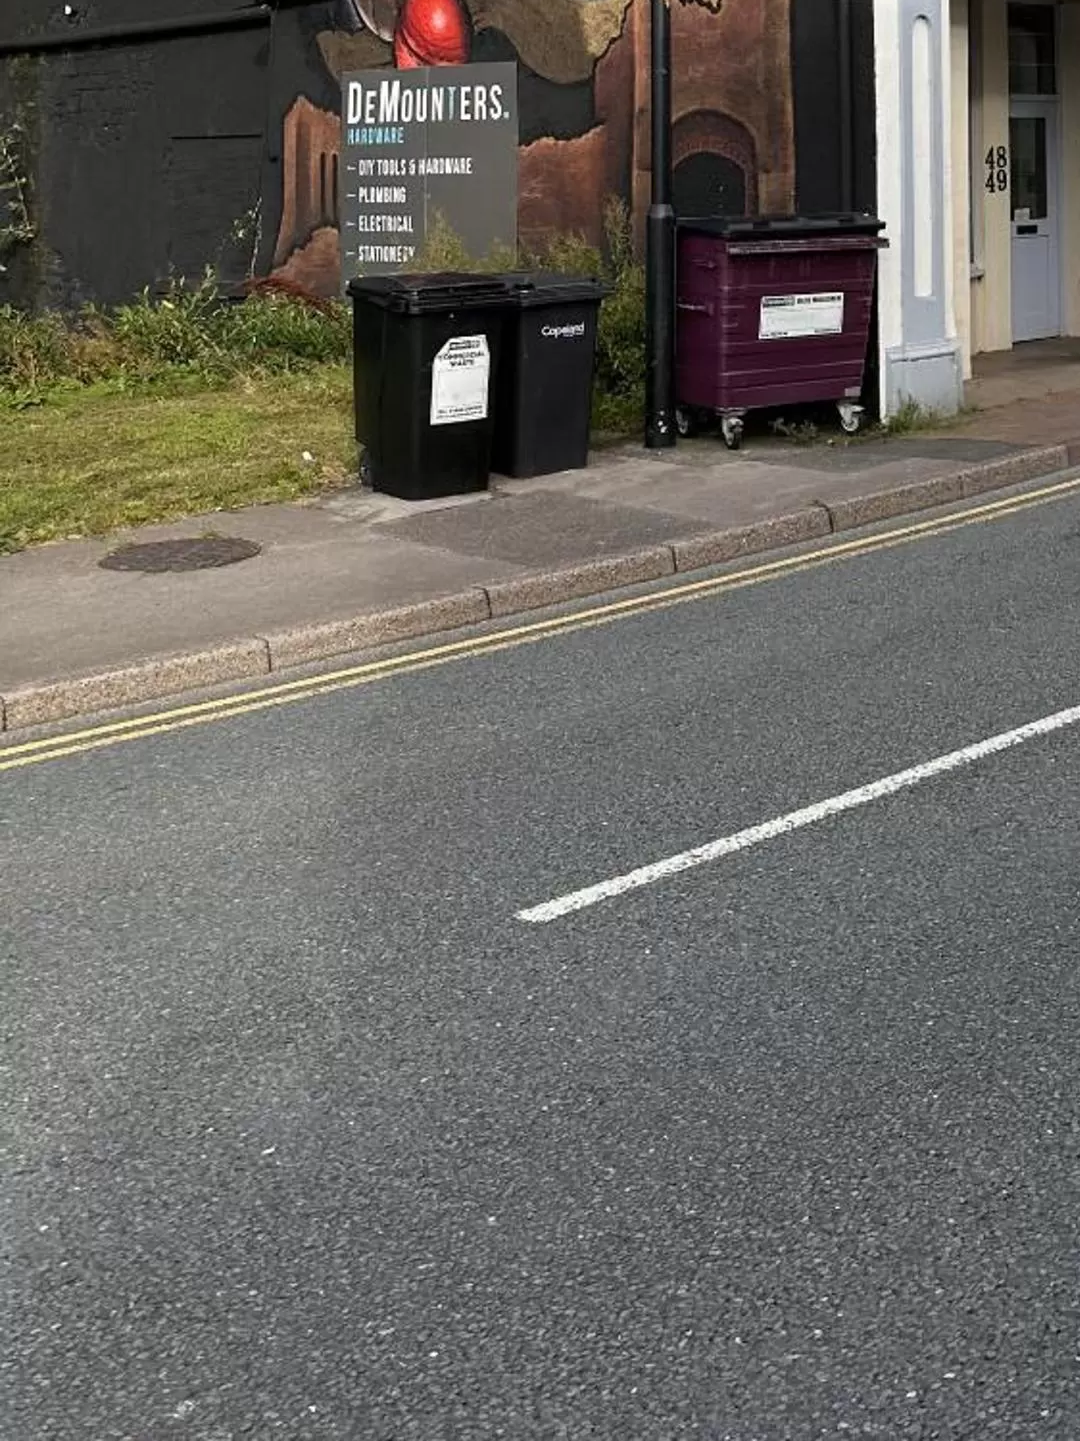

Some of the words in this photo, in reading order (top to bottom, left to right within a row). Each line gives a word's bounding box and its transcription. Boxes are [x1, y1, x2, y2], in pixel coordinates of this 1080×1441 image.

[347, 127, 405, 145] HARDWARE
[985, 145, 1007, 169] 48
[358, 159, 376, 176] DIY
[377, 158, 406, 176] TOOLS
[418, 157, 473, 176] HARDWARE
[985, 169, 1007, 193] 49
[358, 186, 406, 203] PLUMBING
[358, 215, 414, 232] ELECTRICAL
[358, 245, 416, 263] STATIONERY
